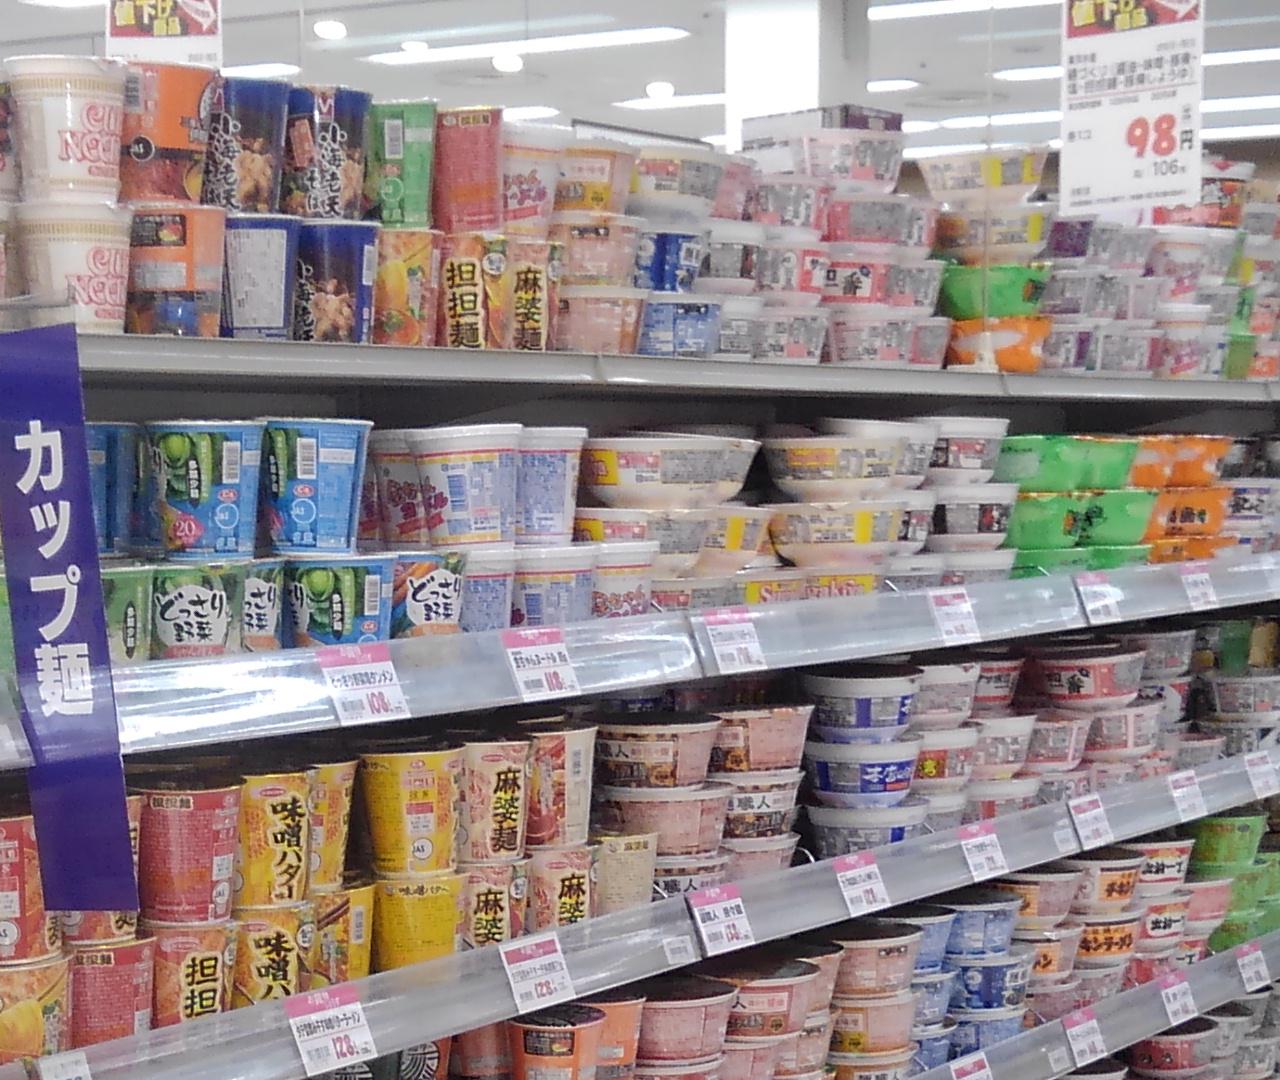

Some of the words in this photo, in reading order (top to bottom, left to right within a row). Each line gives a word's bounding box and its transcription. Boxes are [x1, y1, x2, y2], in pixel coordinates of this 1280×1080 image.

[1126, 113, 1177, 159] 98
[14, 419, 95, 718] カップ麺
[155, 590, 225, 621] どっさり
[407, 574, 463, 603] どっさり
[366, 690, 391, 715] 108
[492, 766, 522, 852] 麻婆麺
